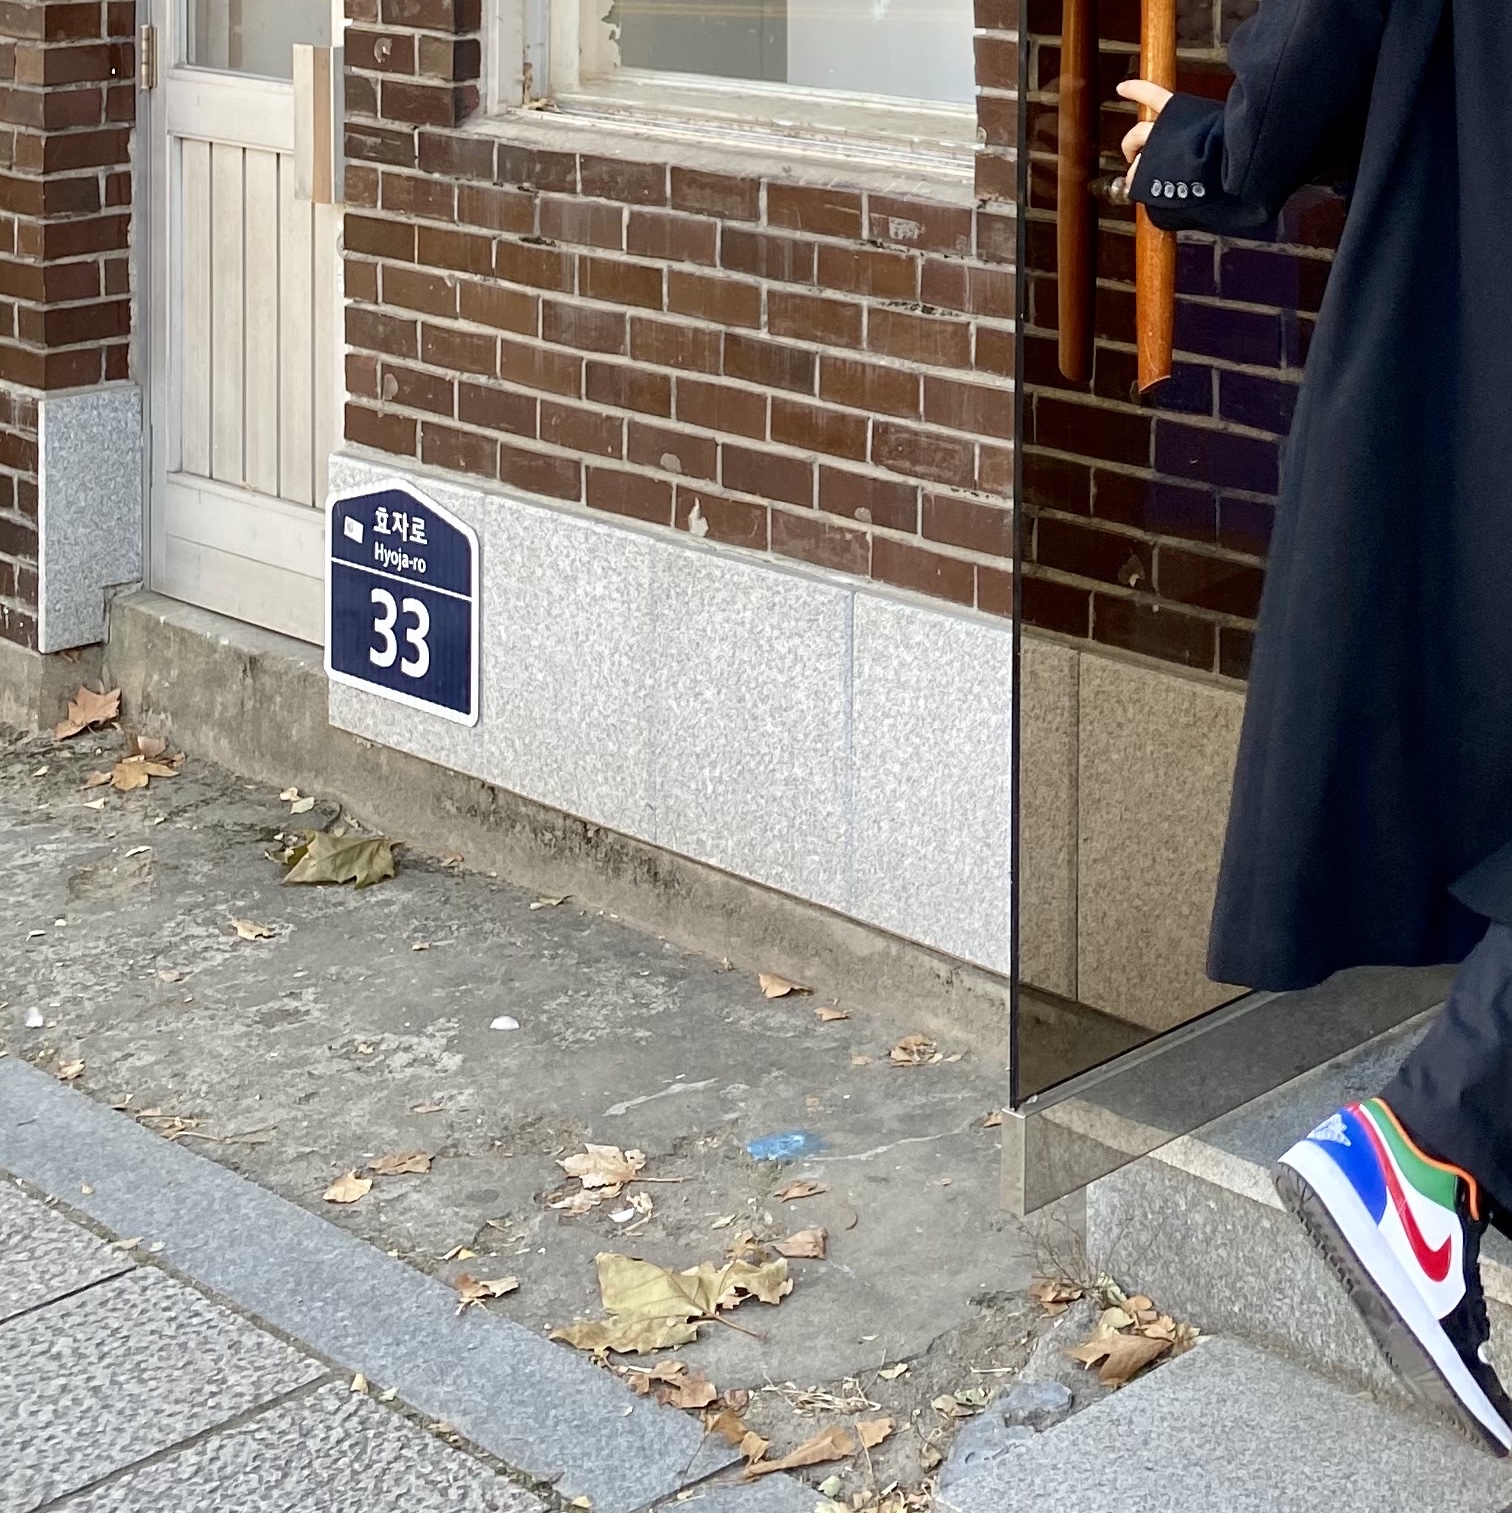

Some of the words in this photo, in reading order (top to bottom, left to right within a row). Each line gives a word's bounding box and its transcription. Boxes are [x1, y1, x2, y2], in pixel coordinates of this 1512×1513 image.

[372, 506, 428, 545] 효자로
[374, 542, 427, 574] Hyoja-ro
[369, 588, 430, 678] 33
